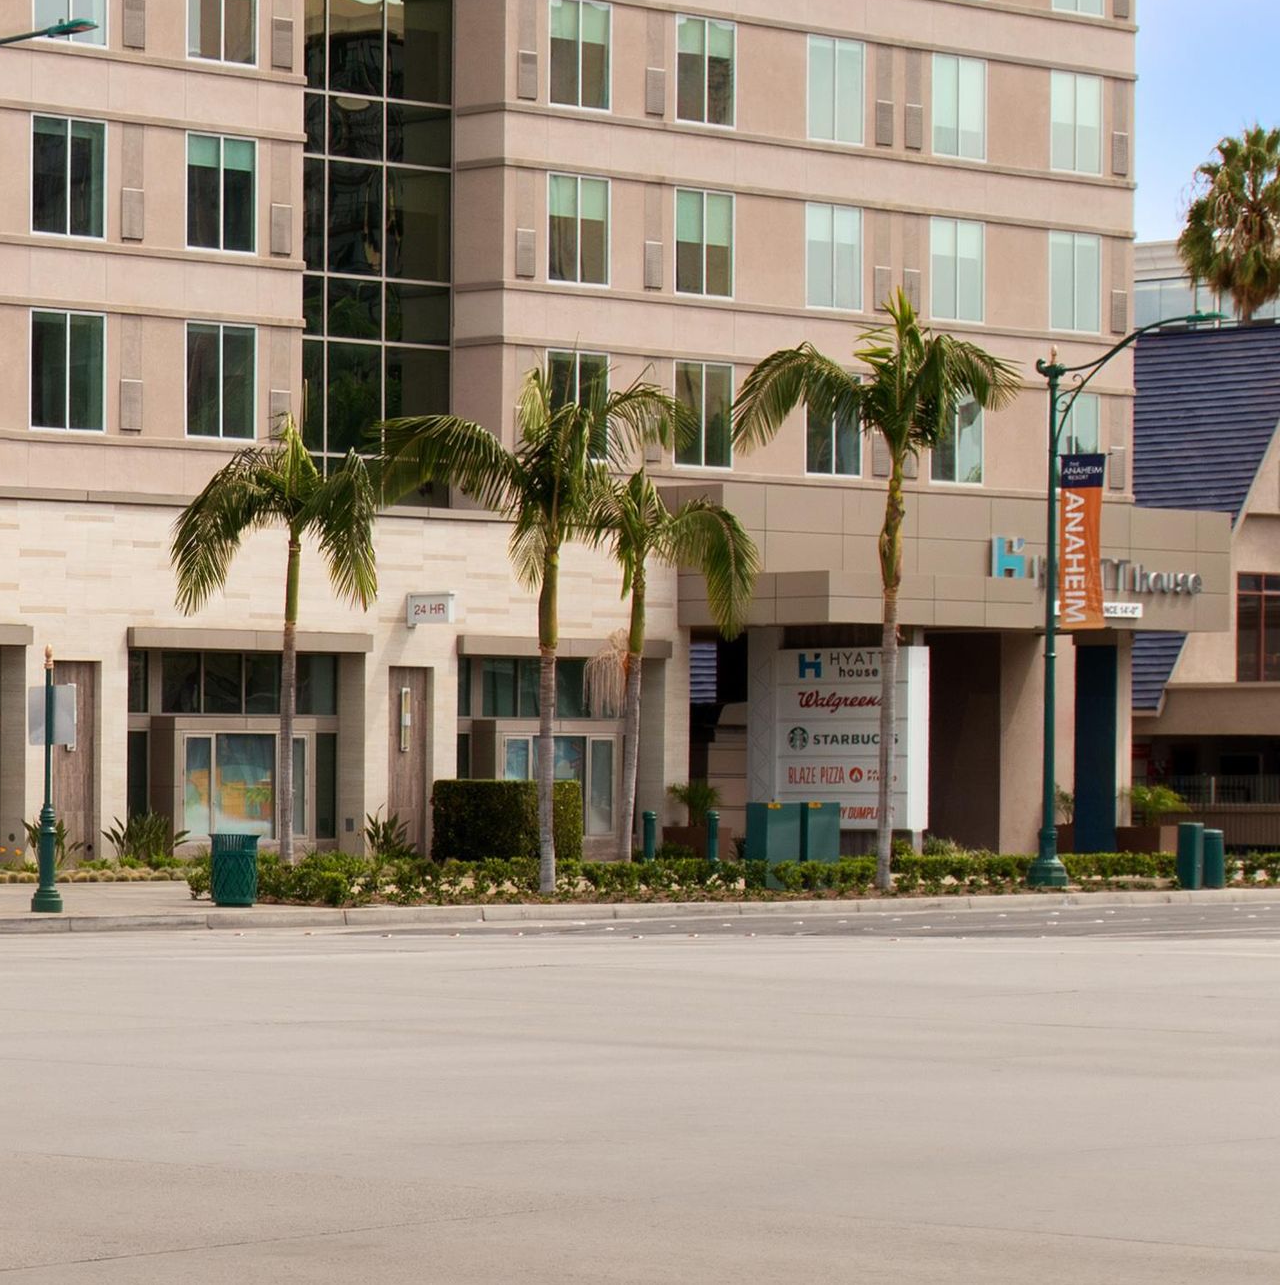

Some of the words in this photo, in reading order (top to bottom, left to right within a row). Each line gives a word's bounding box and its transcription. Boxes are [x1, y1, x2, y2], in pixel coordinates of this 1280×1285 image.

[1063, 466, 1103, 475] ANAHEIM
[1064, 491, 1087, 624] ANAHEIM
[1134, 564, 1203, 595] house
[414, 604, 427, 616] 24
[429, 603, 446, 615] HR
[839, 666, 879, 678] house
[788, 767, 817, 785] BLAZE
[820, 767, 845, 785] PIZZA
